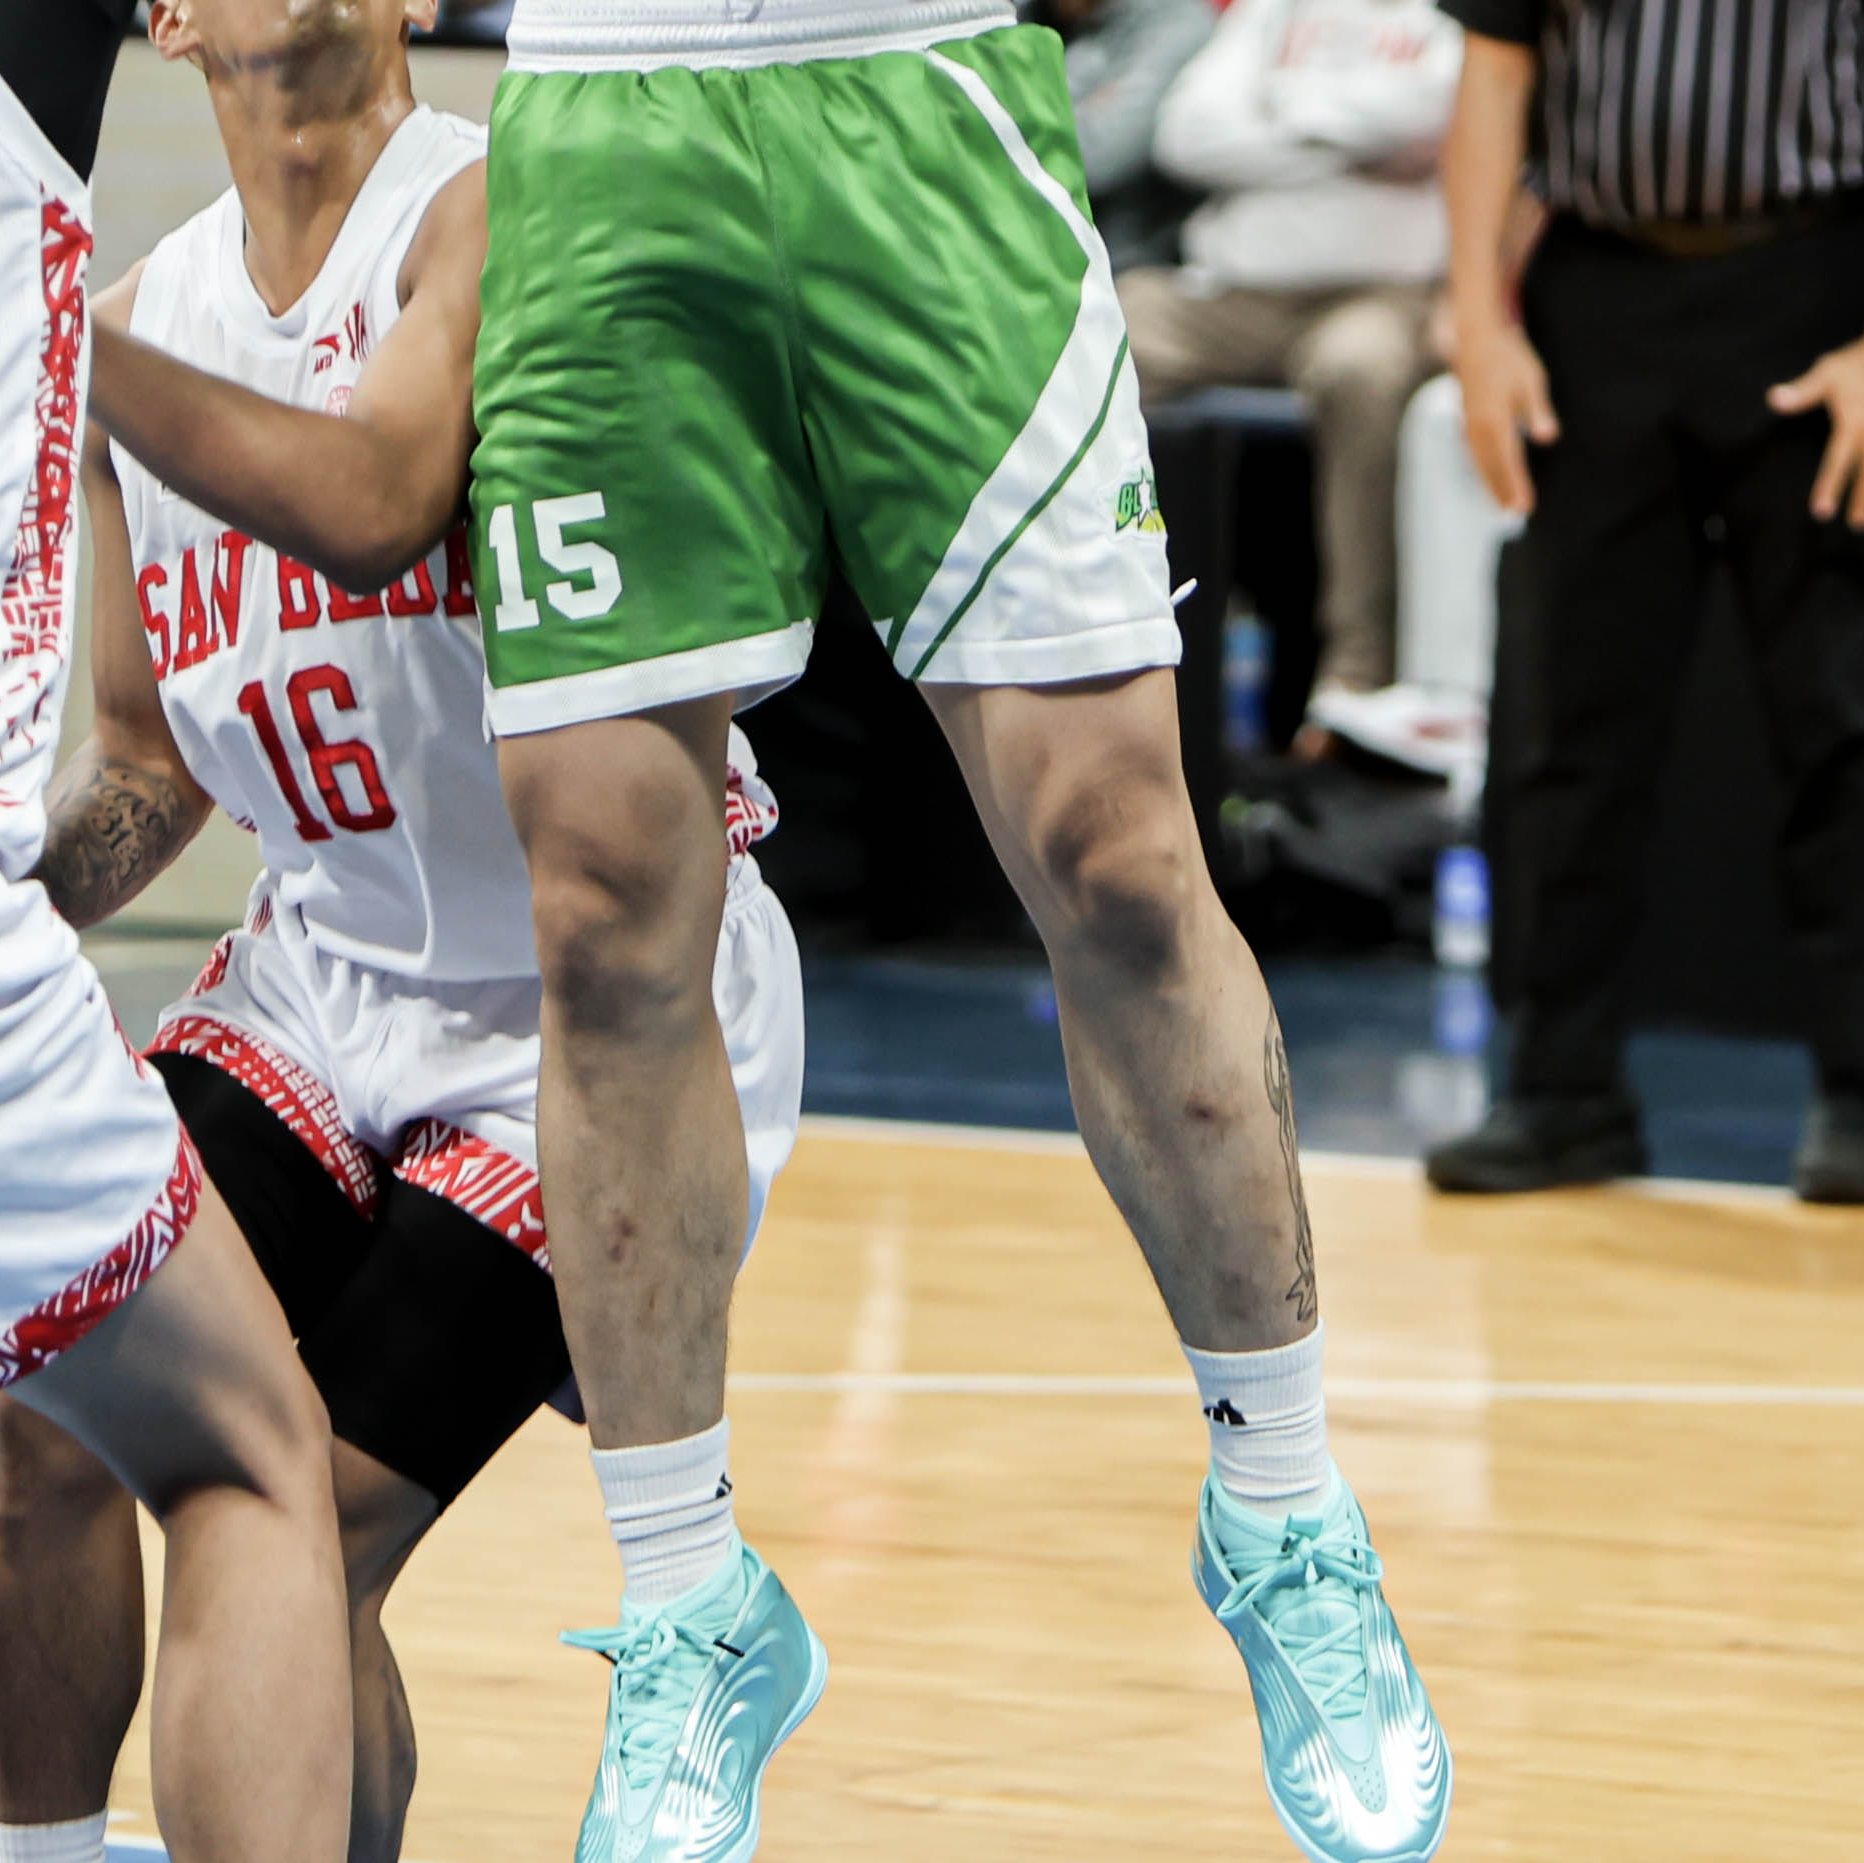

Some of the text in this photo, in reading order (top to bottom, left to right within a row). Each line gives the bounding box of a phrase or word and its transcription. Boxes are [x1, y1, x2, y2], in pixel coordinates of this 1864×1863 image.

[136, 527, 254, 680] SAN
[488, 491, 624, 633] 15
[237, 663, 397, 843] 16
